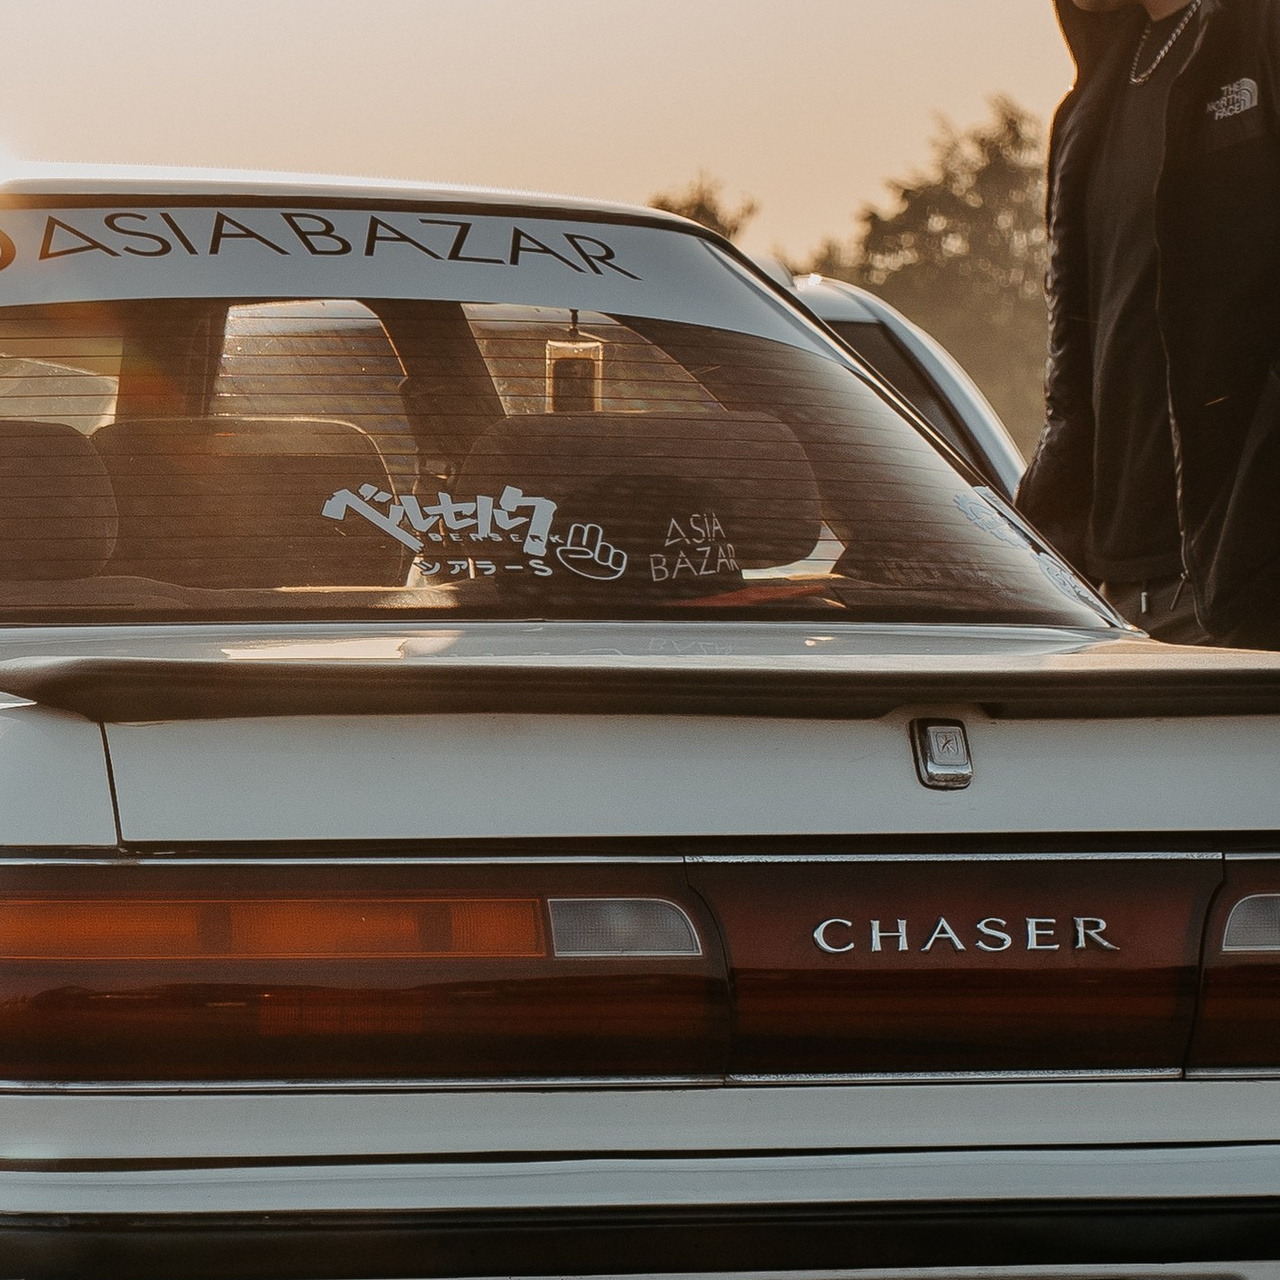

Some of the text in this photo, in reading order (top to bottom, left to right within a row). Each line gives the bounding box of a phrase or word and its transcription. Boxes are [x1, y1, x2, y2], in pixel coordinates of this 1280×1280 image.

[1206, 94, 1241, 113] NORTH
[1221, 80, 1241, 96] THE
[1215, 103, 1241, 120] FACE
[39, 211, 643, 281] ASIABAZAR
[321, 483, 557, 556] ベルセルク
[664, 512, 726, 547] ASIA
[428, 533, 564, 543] BERSERK
[649, 543, 740, 582] BAZAR
[813, 917, 1120, 953] CHASER
